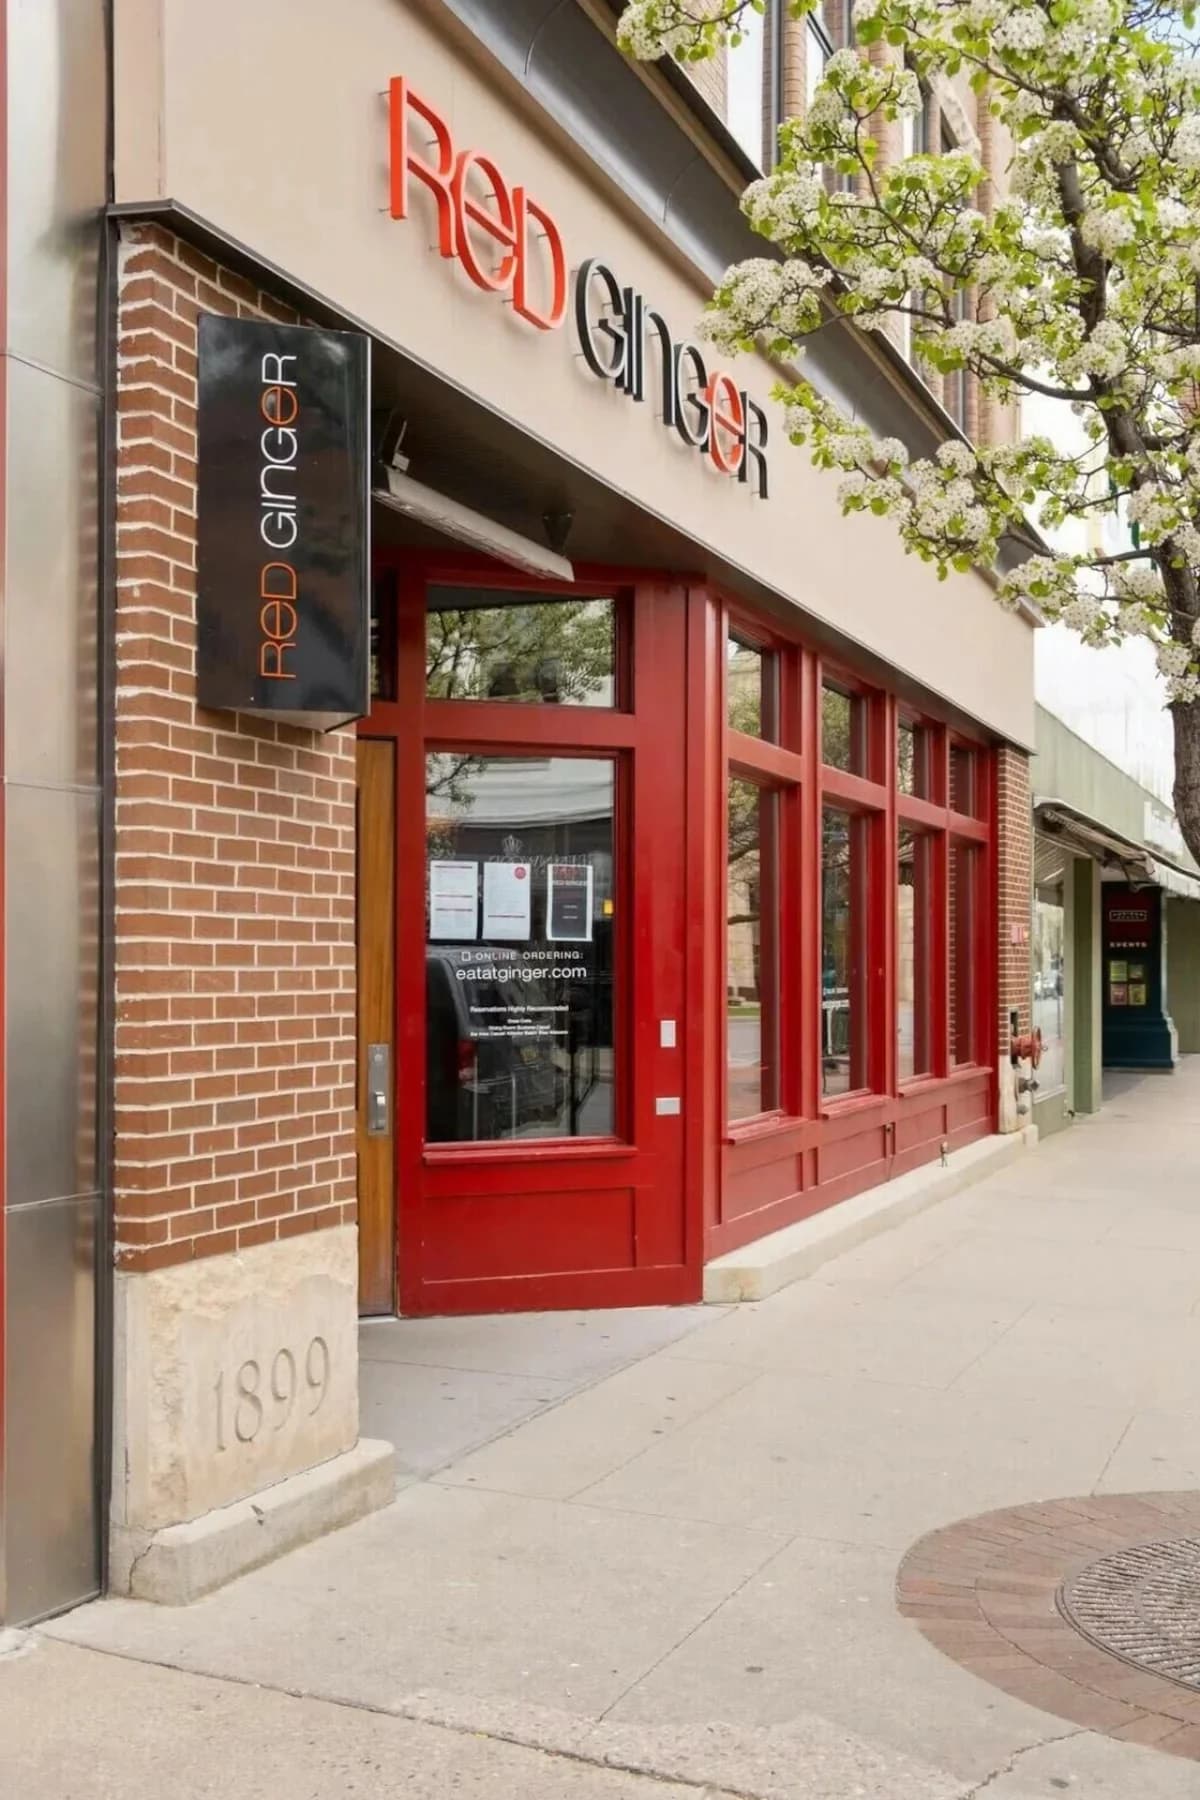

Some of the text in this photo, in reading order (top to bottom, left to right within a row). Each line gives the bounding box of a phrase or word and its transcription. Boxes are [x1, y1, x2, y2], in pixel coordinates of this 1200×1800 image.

[474, 951, 584, 961] ONLINE ORDERING:
[456, 965, 587, 983] eatatginger.com
[213, 1335, 330, 1453] 1899
